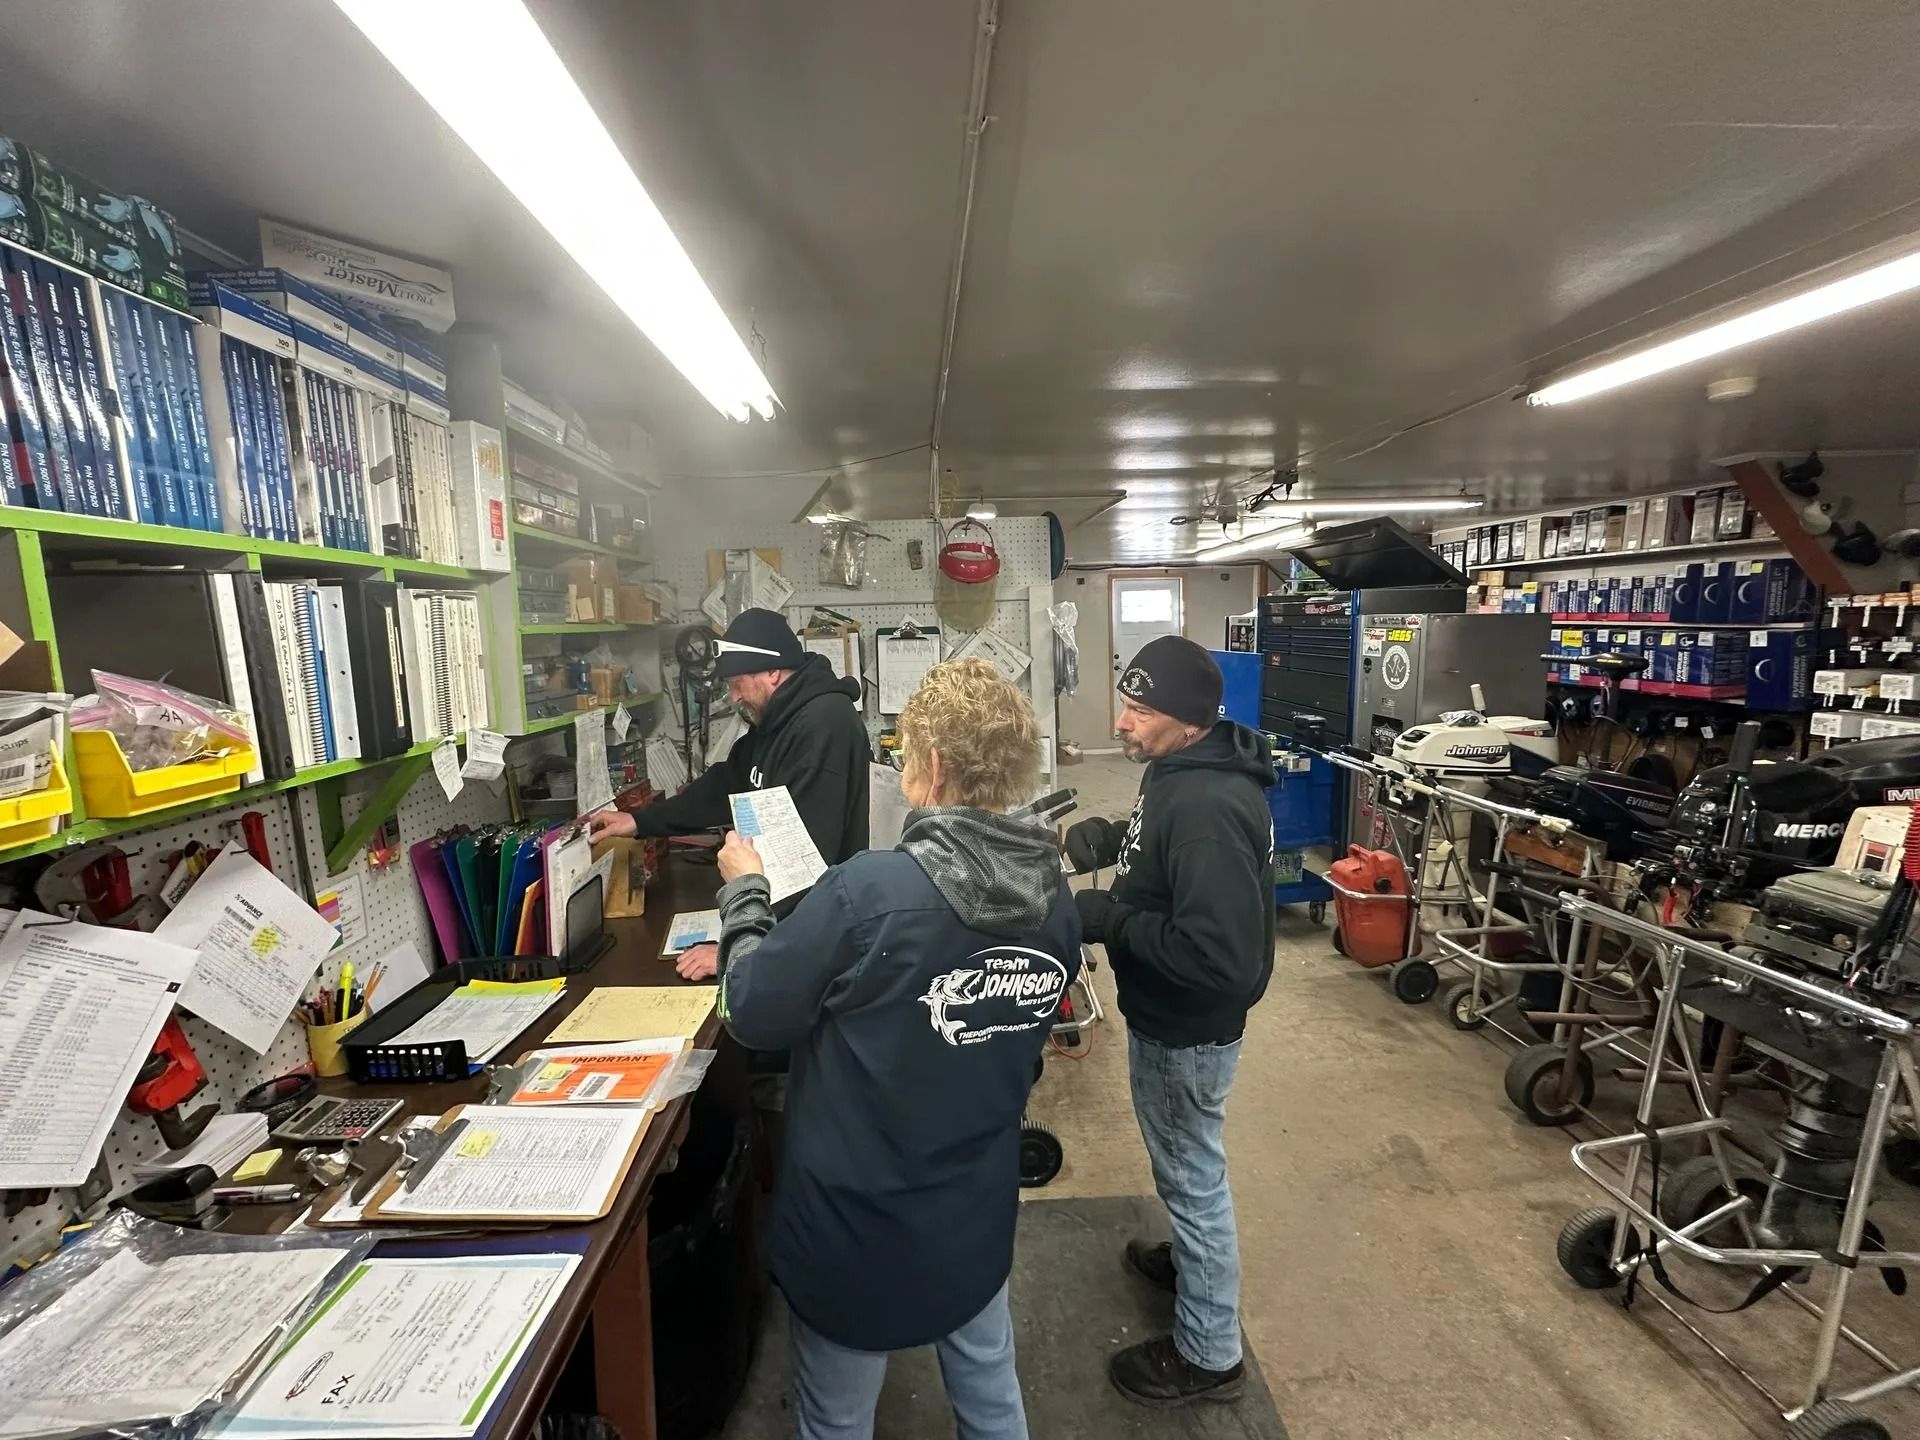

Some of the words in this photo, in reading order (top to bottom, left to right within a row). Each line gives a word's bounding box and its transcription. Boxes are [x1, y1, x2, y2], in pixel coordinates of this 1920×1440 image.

[4, 304, 15, 325] 2009
[30, 315, 41, 336] 2009
[56, 327, 67, 346] 2009
[80, 329, 91, 348] 2009
[278, 338, 290, 347] 100
[60, 346, 69, 358] SE
[84, 348, 92, 360] SE
[63, 359, 74, 383] E-TEC
[87, 362, 98, 385] E-TEC
[145, 377, 154, 398] E-TEC
[0, 442, 10, 458] P/N
[36, 451, 47, 466] P/N
[60, 458, 70, 473] P/N
[83, 464, 93, 479] P/N
[106, 463, 115, 477] P/N
[136, 469, 145, 482] P/N
[40, 466, 53, 497] 5007805
[63, 472, 76, 501] 5007811
[163, 474, 171, 487] P/N
[86, 478, 99, 508] 5007820
[207, 482, 215, 495] P/N
[1388, 630, 1412, 642] JEGS
[286, 697, 296, 716] DTS
[159, 710, 184, 724] AA
[1375, 728, 1397, 739] STURGIS
[1446, 746, 1503, 755] Johnson
[1774, 823, 1845, 838] MERC
[240, 898, 264, 918] ADVANCE
[984, 957, 1030, 971] Team
[978, 971, 1062, 1001] JOHNSON's
[1018, 998, 1036, 1006] BOATS
[571, 1055, 651, 1064] IMPORTANT
[320, 1373, 355, 1405] FAX
